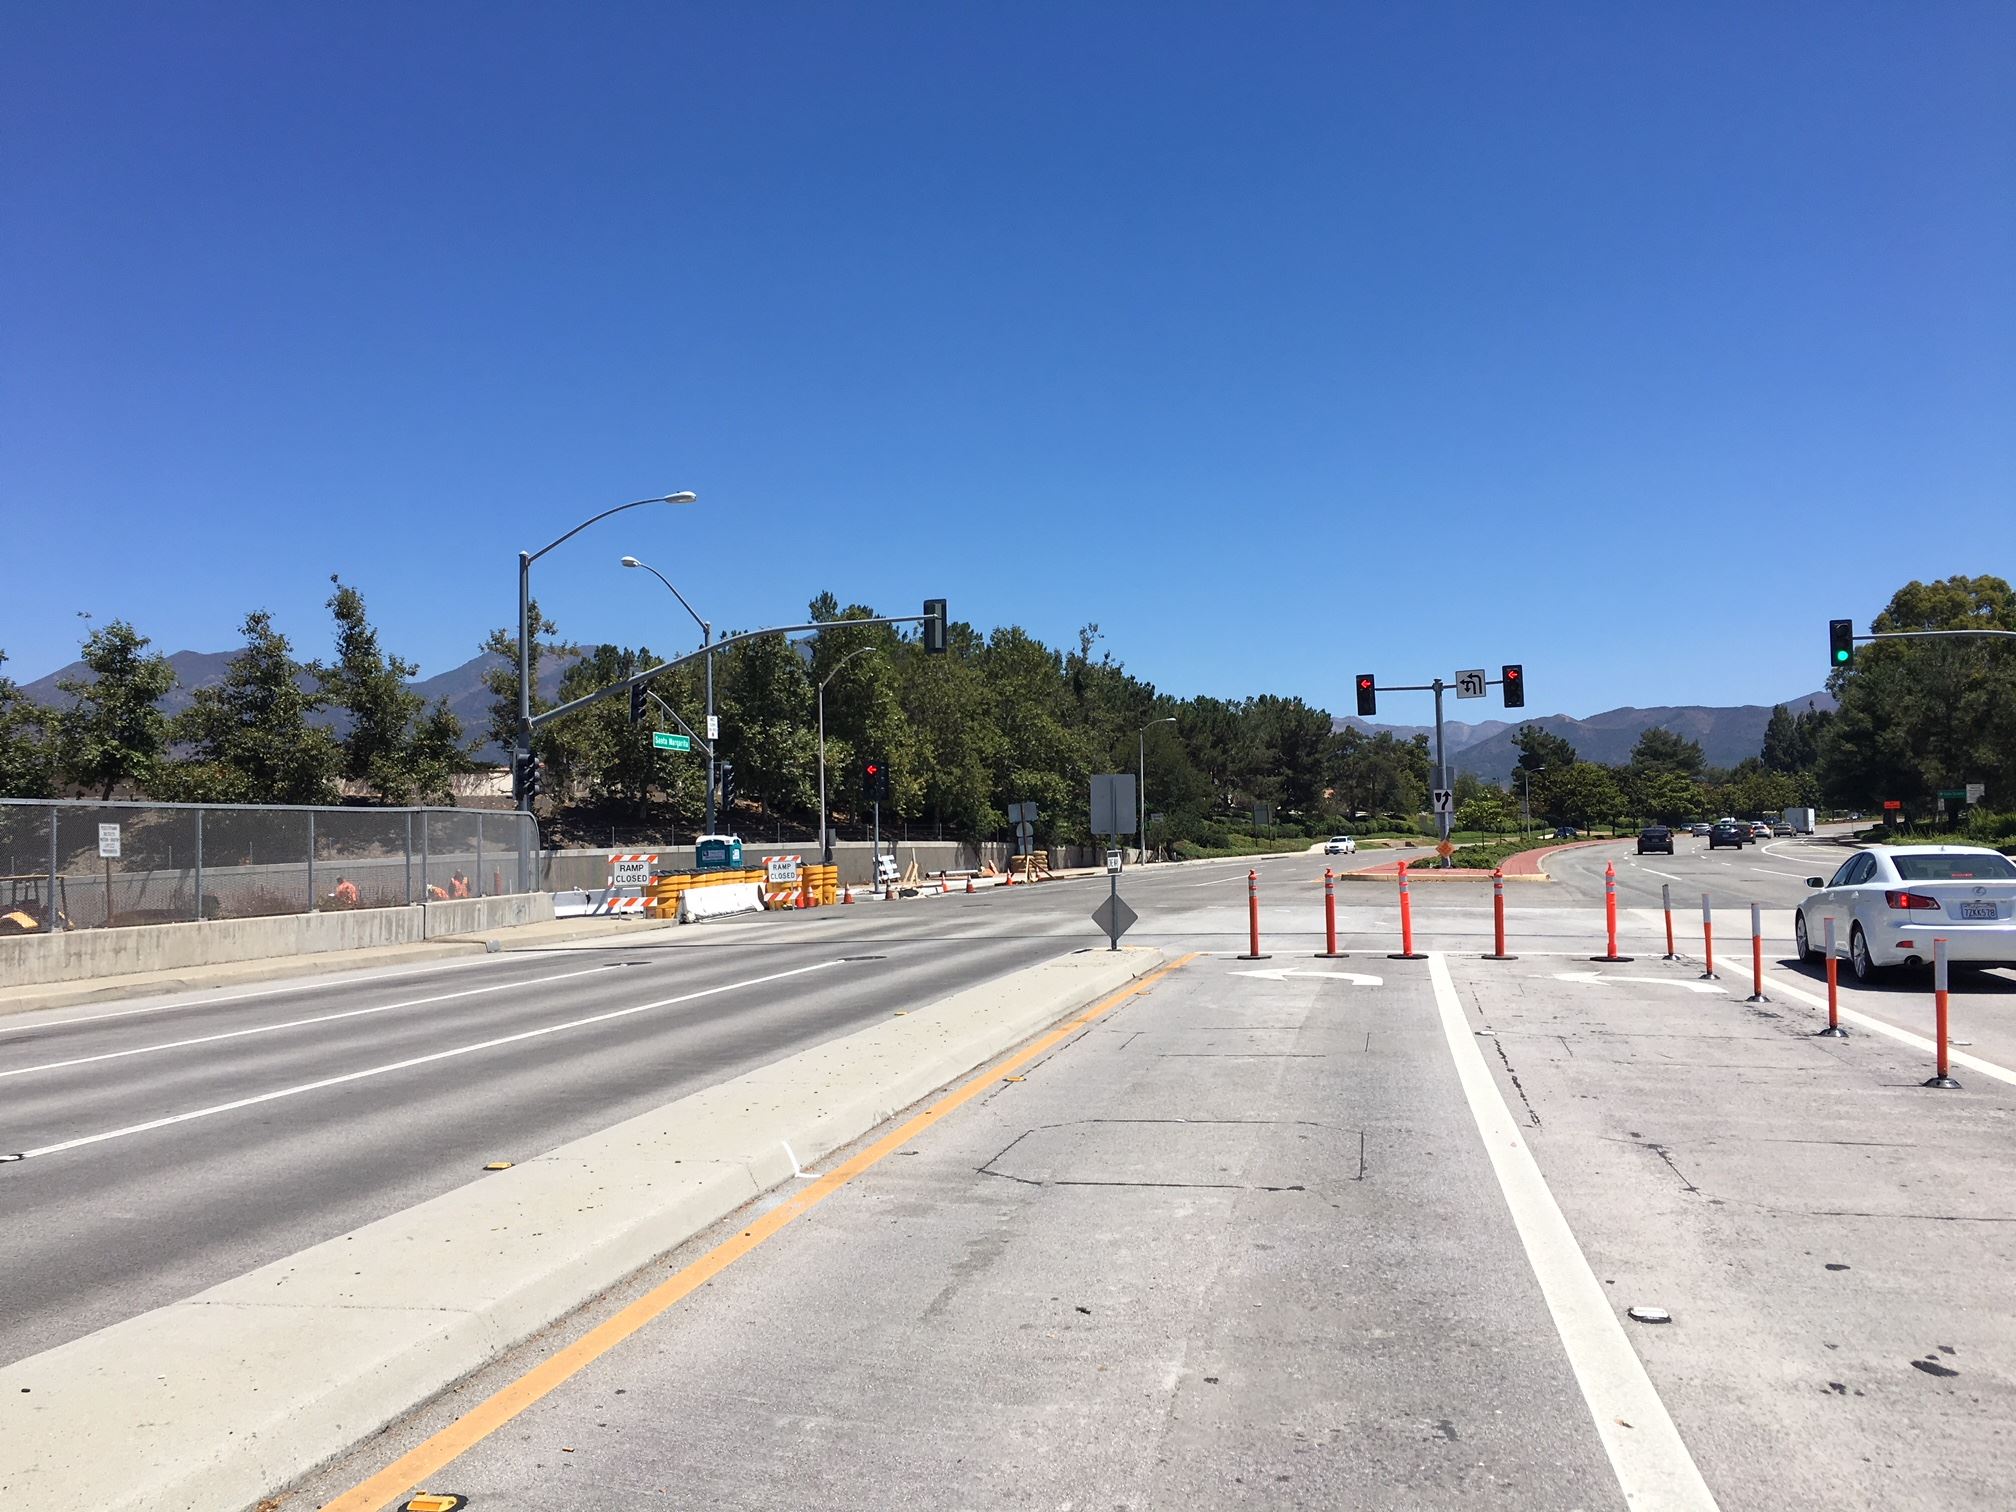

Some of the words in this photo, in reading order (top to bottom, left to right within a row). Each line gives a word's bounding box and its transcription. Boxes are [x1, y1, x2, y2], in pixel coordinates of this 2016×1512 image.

[655, 735, 668, 744] Santa
[668, 738, 689, 748] Margarita
[619, 864, 644, 872] RAMP
[615, 874, 648, 883] CLOSED
[770, 872, 795, 880] CLOSED
